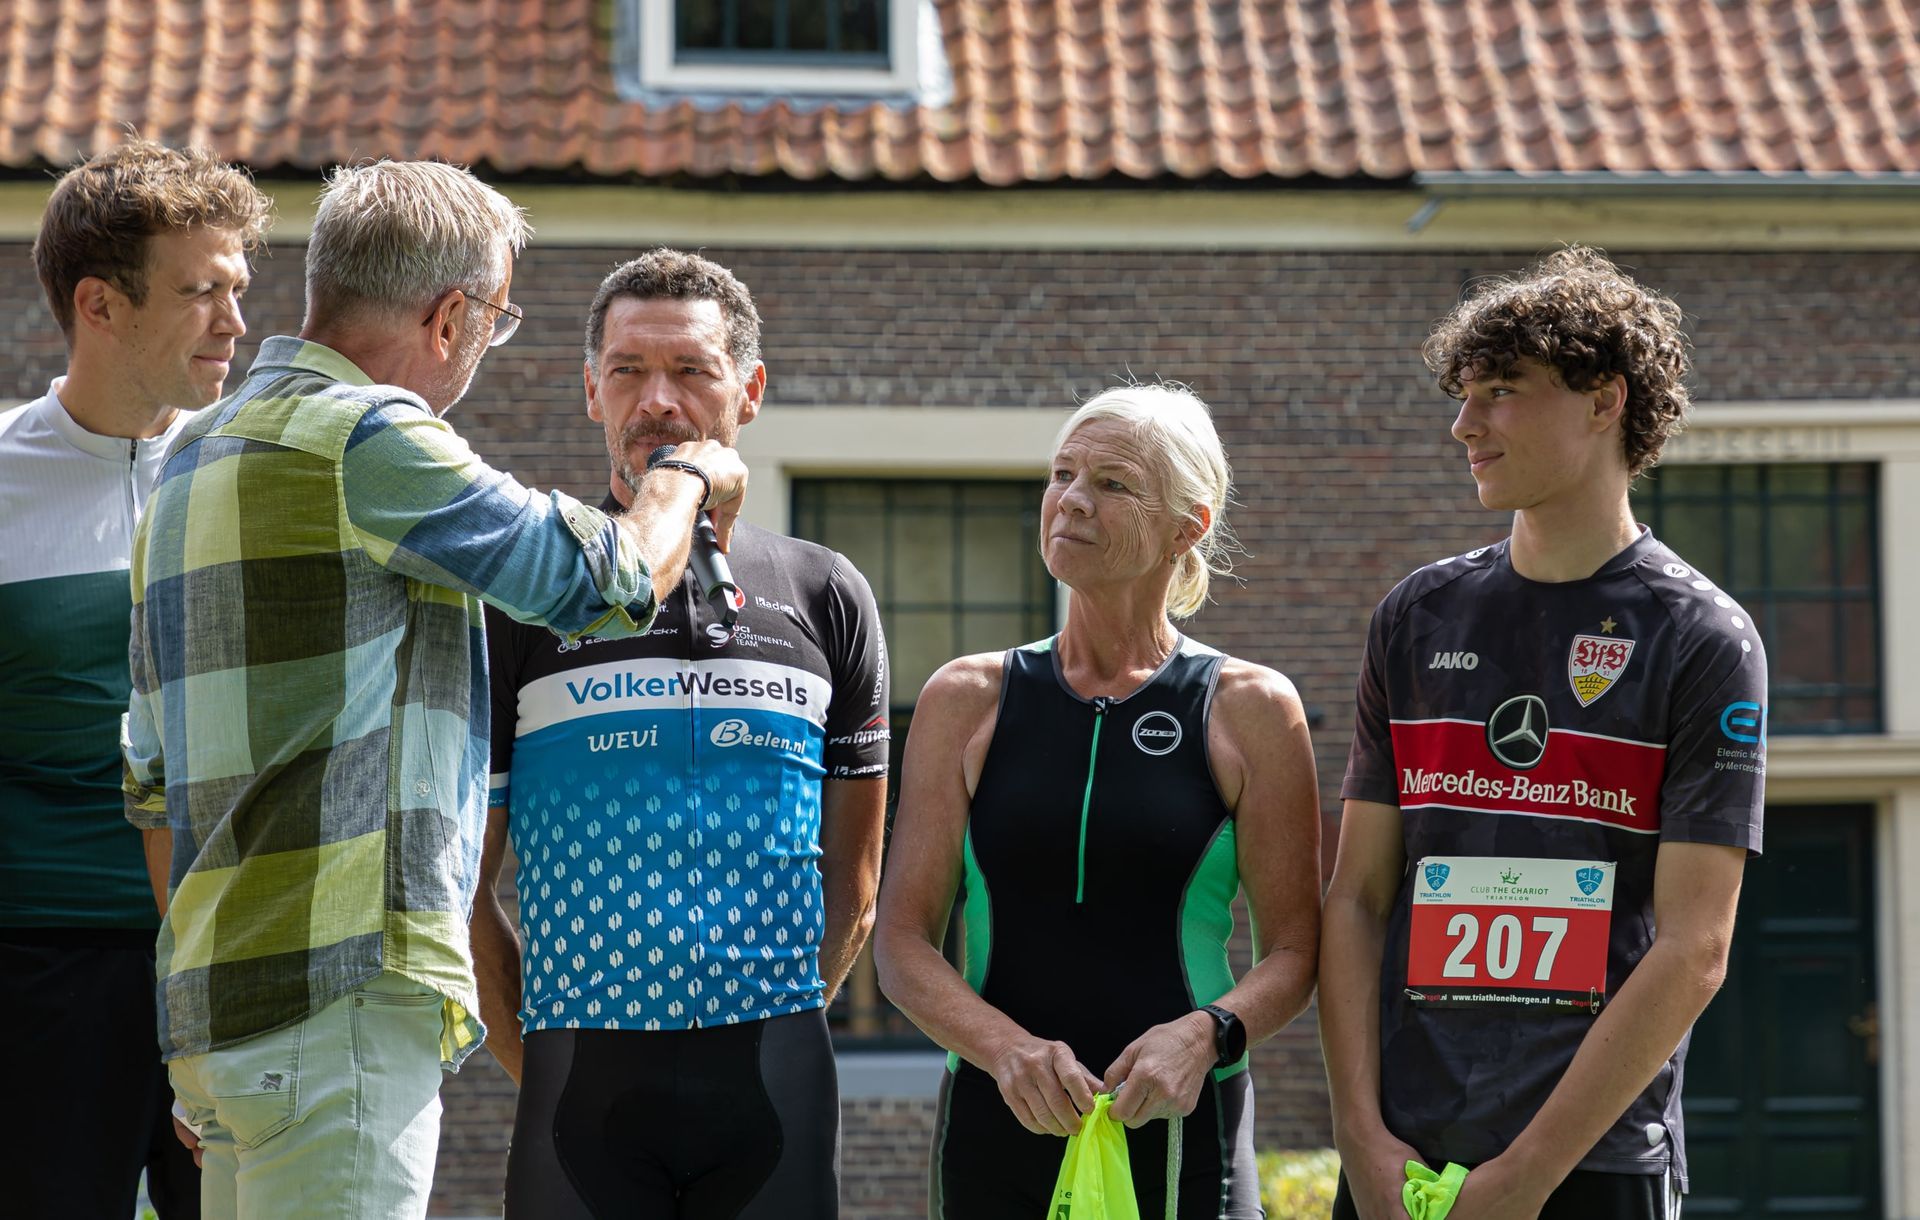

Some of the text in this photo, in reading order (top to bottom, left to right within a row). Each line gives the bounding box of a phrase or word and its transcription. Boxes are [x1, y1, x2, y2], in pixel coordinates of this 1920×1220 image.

[732, 624, 751, 634] UCI
[734, 631, 795, 649] CONTINENTAL
[735, 638, 759, 648] TEAM
[1428, 651, 1479, 670] JAKO
[566, 671, 808, 706] VolkerWessels
[713, 719, 807, 755] Beelen.nl
[1717, 747, 1748, 758] Electric
[1714, 760, 1726, 771] by
[1401, 768, 1637, 817] Mercedes-Benz Bank
[1470, 886, 1549, 896] CLUB THE CHARIOT
[1569, 896, 1606, 904] TRIATHLON
[1442, 912, 1569, 981] 207
[1452, 993, 1551, 1005] www.triathloneibergen.nl
